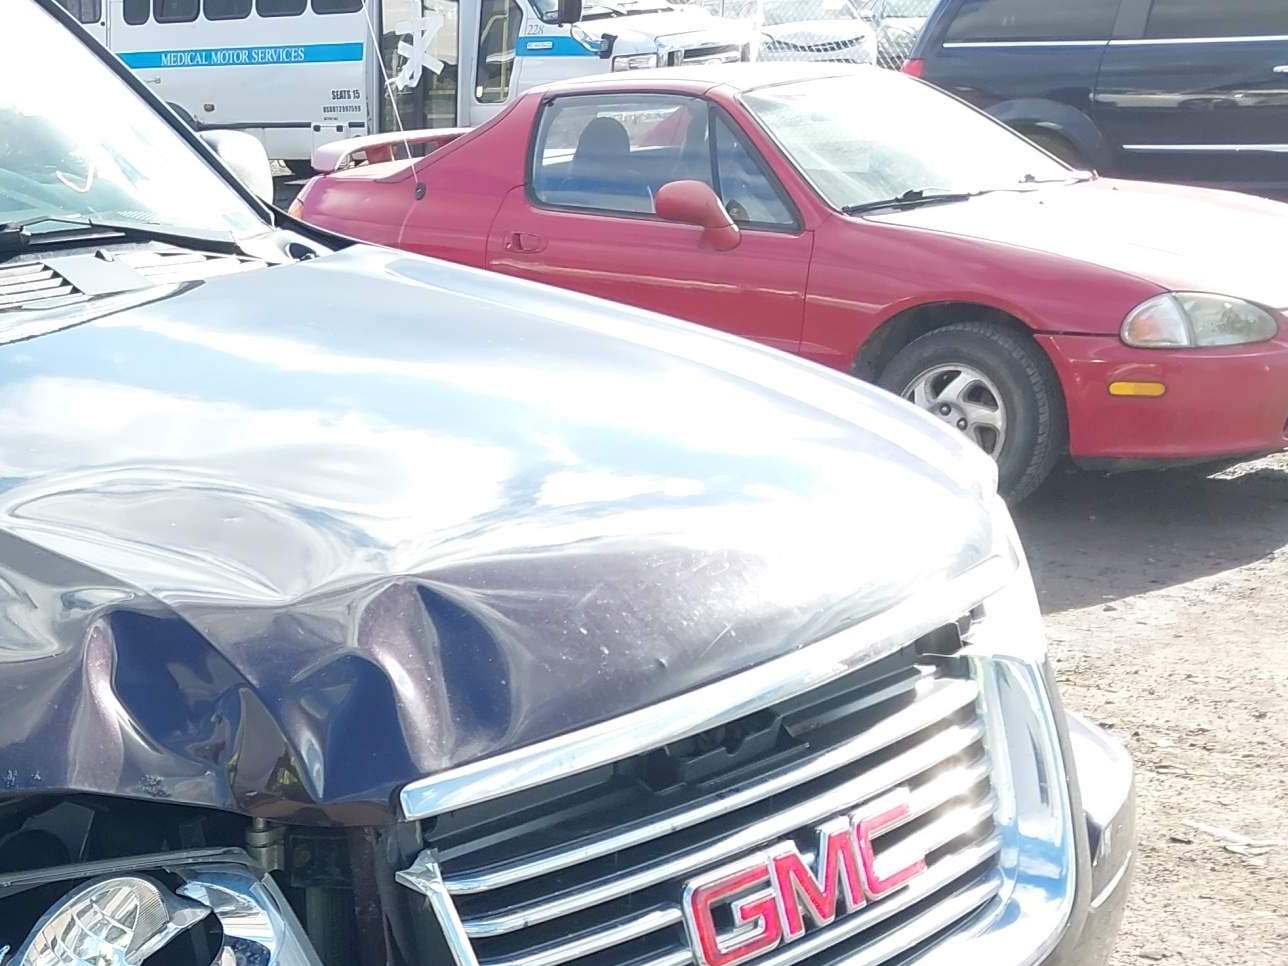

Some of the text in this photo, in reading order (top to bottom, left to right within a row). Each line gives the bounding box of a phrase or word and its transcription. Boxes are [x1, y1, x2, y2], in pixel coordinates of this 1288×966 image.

[161, 47, 305, 66] MEDICAL MOTOR SERVICES
[332, 89, 360, 100] SEATS 15
